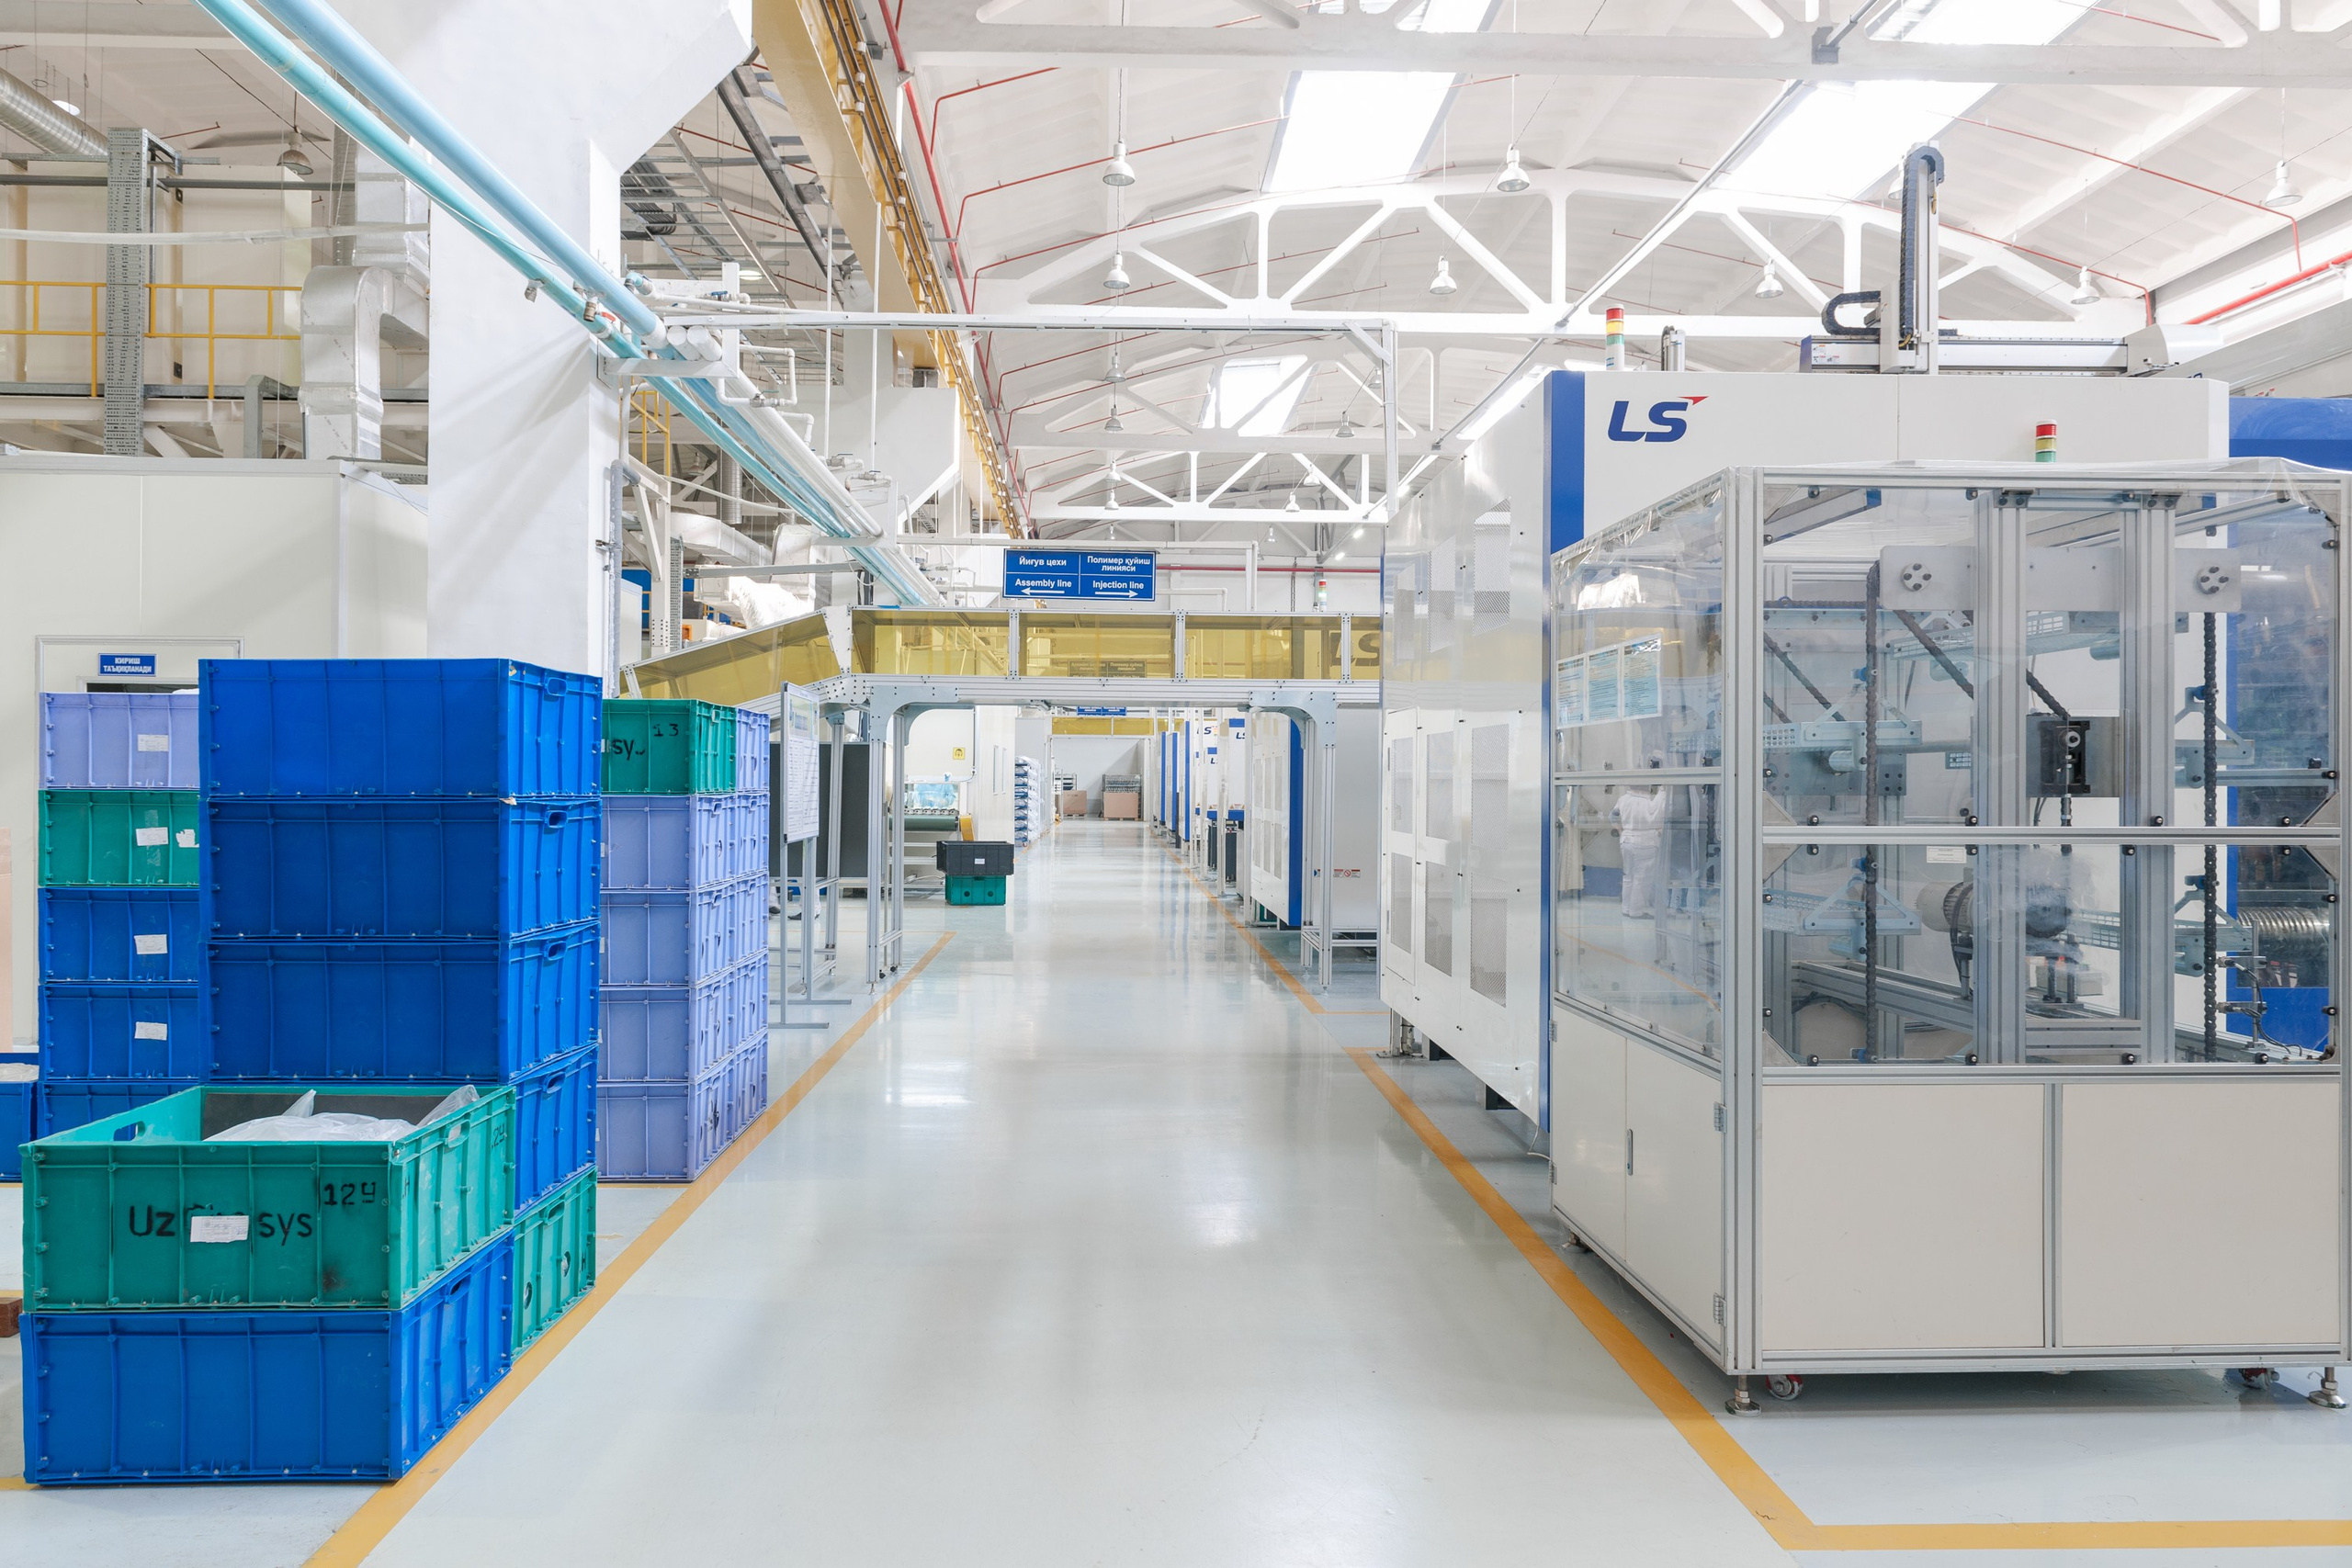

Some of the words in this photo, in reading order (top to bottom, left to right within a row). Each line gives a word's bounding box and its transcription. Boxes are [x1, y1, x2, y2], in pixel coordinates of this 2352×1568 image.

[1607, 399, 1689, 443] LS
[1046, 558, 1067, 567] цехи
[1087, 556, 1123, 566] Полимер
[1015, 579, 1056, 589] Assembly
[1057, 580, 1072, 588] line
[1092, 581, 1127, 590] Injection
[1129, 581, 1145, 590] line
